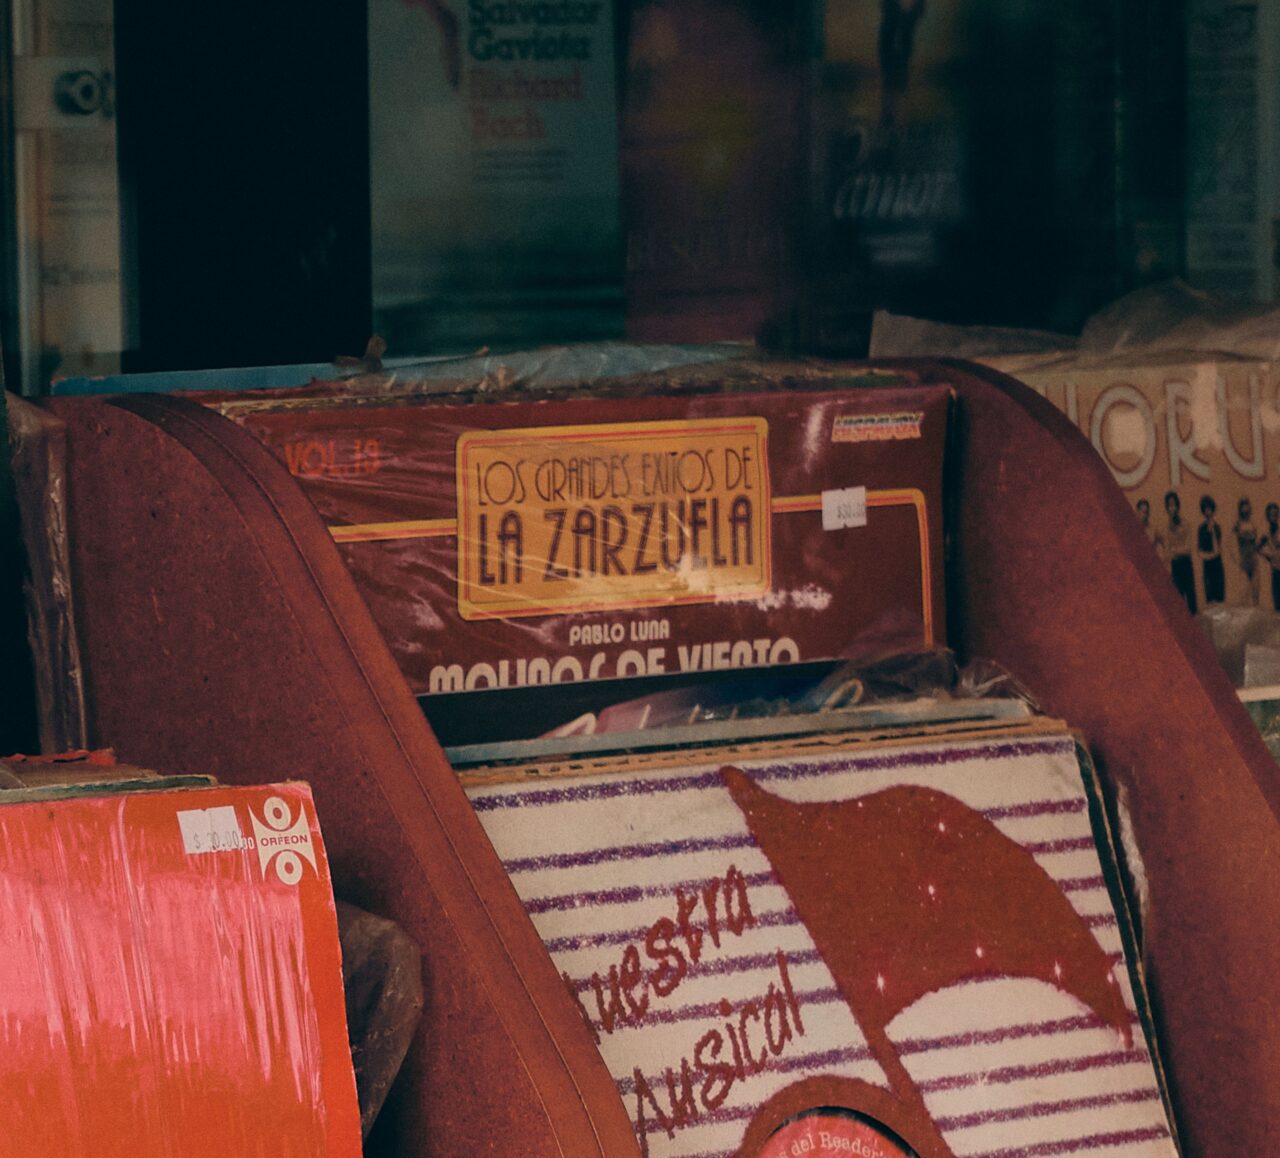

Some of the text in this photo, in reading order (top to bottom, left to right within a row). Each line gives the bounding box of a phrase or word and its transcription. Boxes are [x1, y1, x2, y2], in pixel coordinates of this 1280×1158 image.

[476, 460, 526, 506] LOS
[535, 453, 631, 502] GRANDES
[724, 446, 753, 491] DE
[477, 494, 754, 586] LA ZARZUELA
[569, 619, 670, 646] PABLO LUNA
[260, 833, 309, 848] ORFEON
[791, 1132, 815, 1158] del
